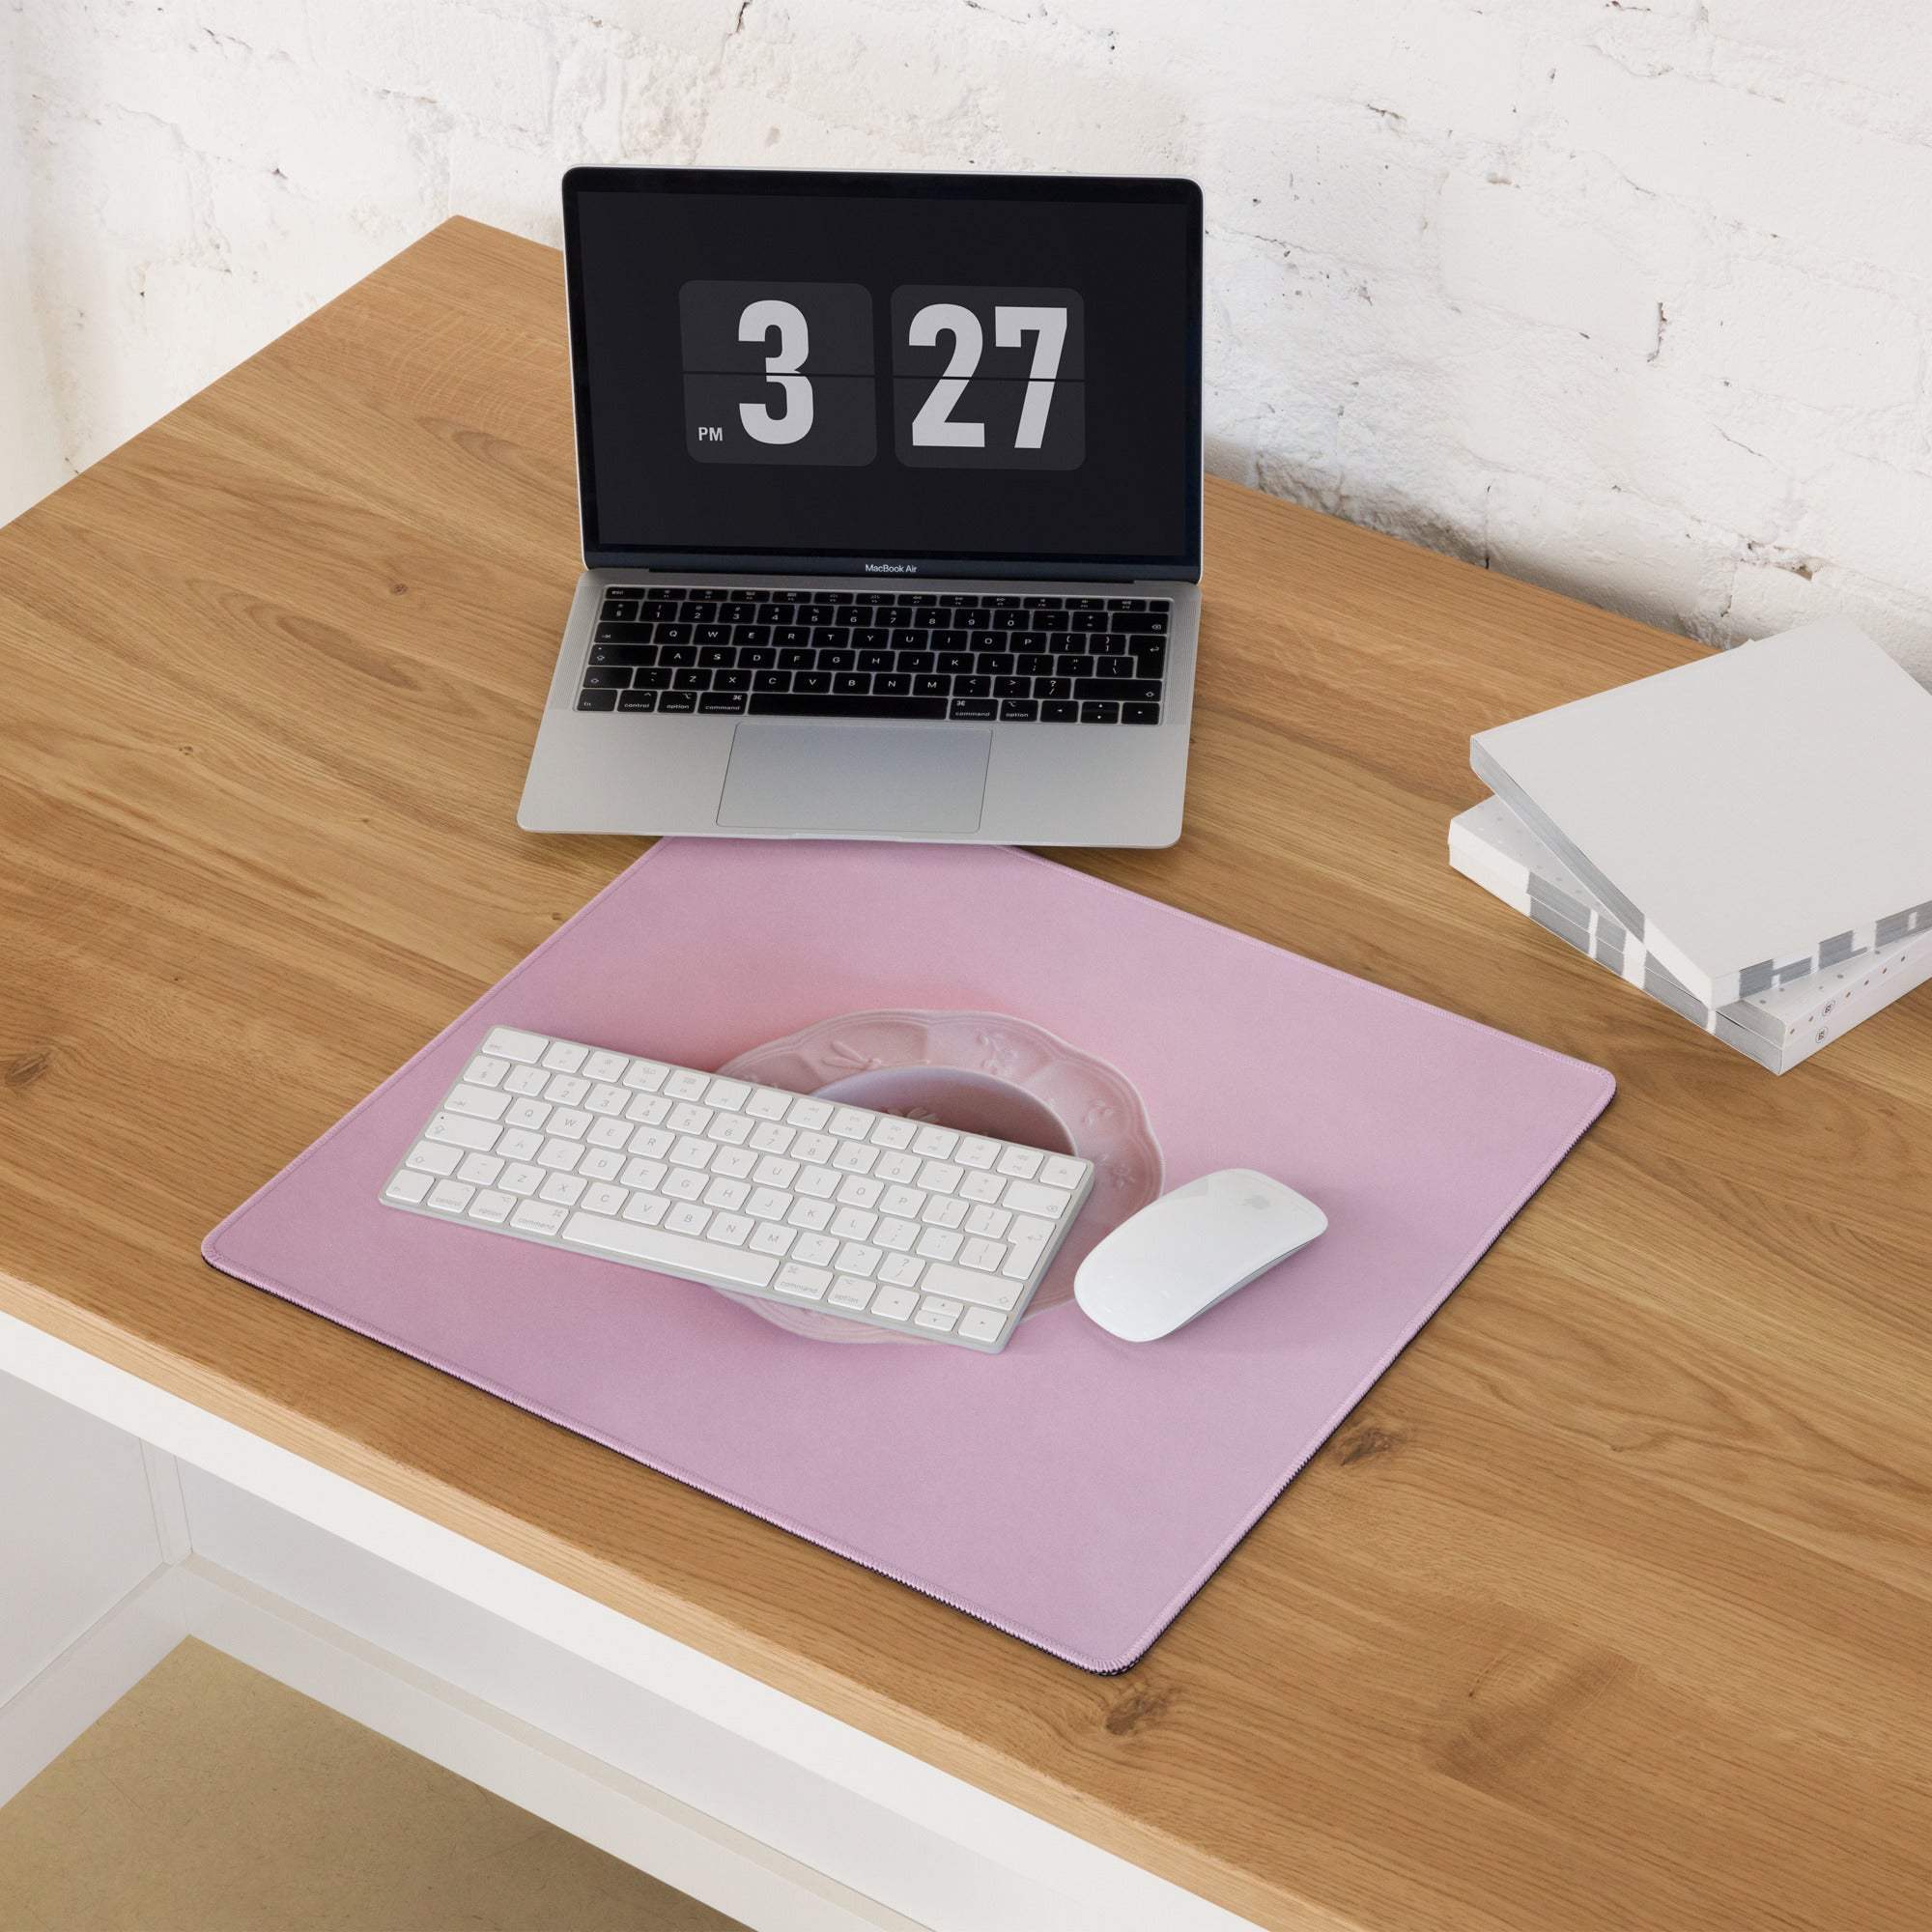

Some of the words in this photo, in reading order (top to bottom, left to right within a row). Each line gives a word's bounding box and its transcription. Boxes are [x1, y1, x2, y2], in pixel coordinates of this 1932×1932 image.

[738, 300, 813, 444] 3
[909, 303, 1067, 448] 27
[698, 427, 723, 440] PM
[866, 564, 904, 573] MacBook
